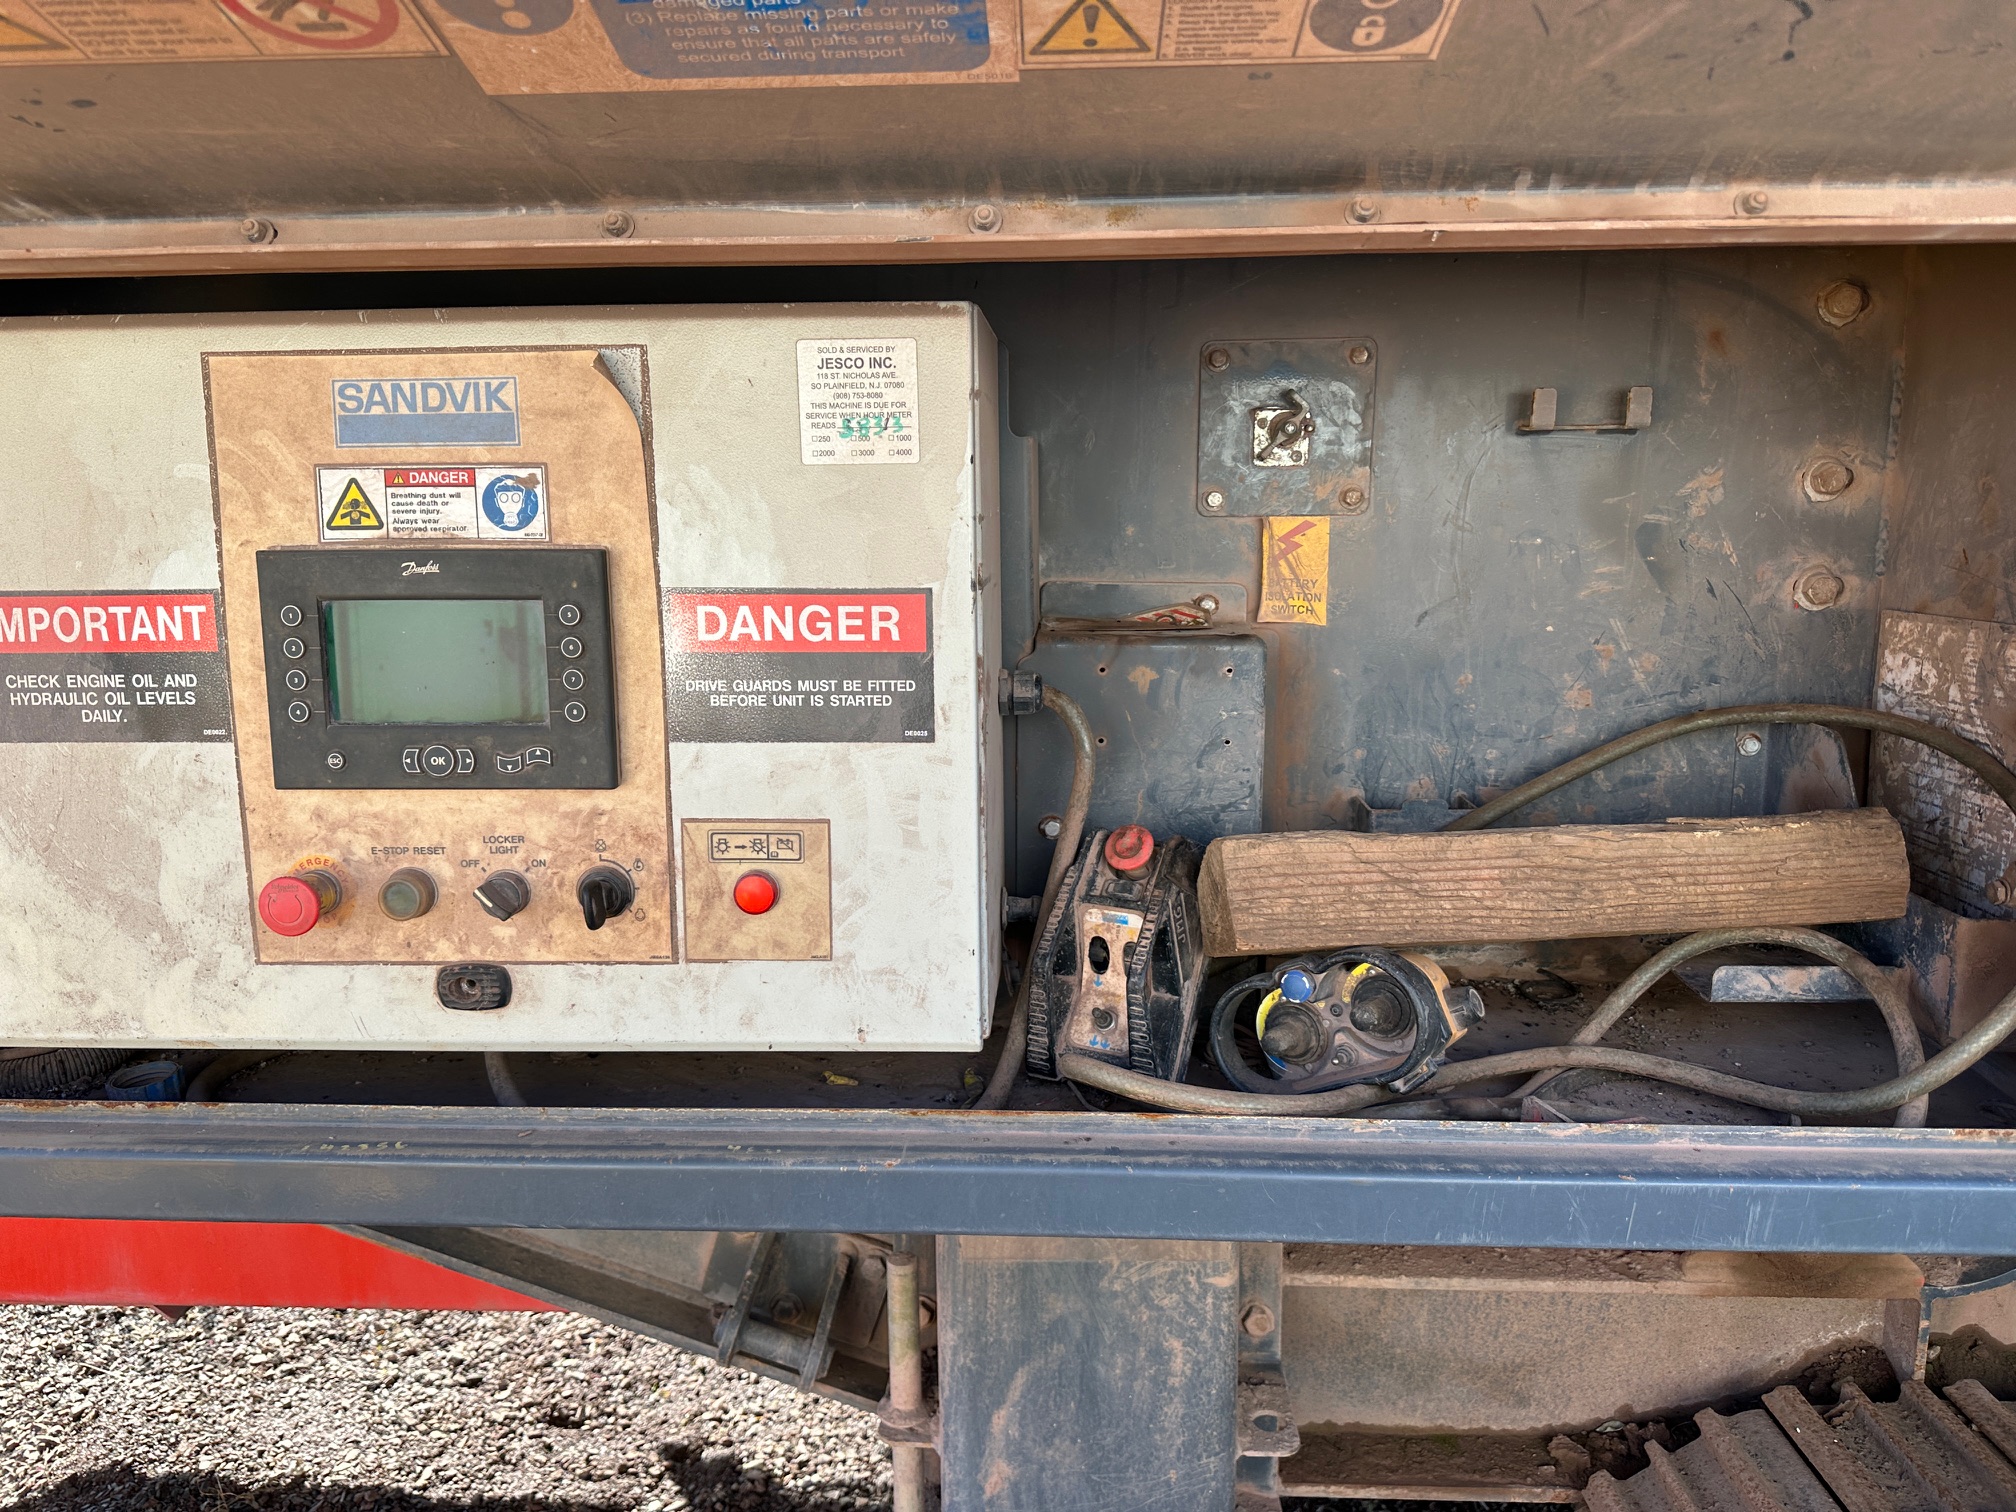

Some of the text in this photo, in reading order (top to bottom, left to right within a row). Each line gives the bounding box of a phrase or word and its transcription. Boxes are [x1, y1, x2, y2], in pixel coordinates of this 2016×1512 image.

[748, 0, 801, 8] parts
[625, 4, 959, 26] (3) Replace missing parts or make
[665, 18, 949, 38] repairs as found necessary to
[672, 31, 957, 50] ensure that all parts are safely
[677, 47, 906, 64] secured during transport
[817, 346, 837, 354] SOLD
[839, 346, 844, 354] &
[886, 345, 895, 353] BY
[817, 356, 897, 370] JESCO INC.
[882, 371, 899, 379] AVE.
[823, 382, 867, 391] PLAINFIELD,
[884, 381, 904, 389] 07080
[337, 381, 513, 414] SANDVIK
[833, 392, 850, 400] (908)
[810, 402, 827, 410] THIS
[863, 411, 885, 419] HOUR
[818, 449, 835, 457] 2000
[409, 472, 469, 484] DANGER
[390, 492, 427, 500] Breathing
[401, 560, 440, 576] Danfoss
[1268, 578, 1319, 590] BATTERY
[1265, 592, 1322, 603] ISOLATION
[1270, 605, 1316, 616] SWITCH
[0, 605, 206, 643] MPORTANT
[697, 604, 901, 643] DANGER
[5, 673, 198, 689] CHECK ENGINE OIL AND
[685, 680, 916, 692] DRIVE GUARDS MUST BE FITTED
[10, 691, 196, 706] HYDRAULIC OIL LEVELS
[710, 695, 892, 707] BEFORE UNIT IS STARTED
[81, 709, 128, 723] DAILY.
[430, 756, 446, 766] OK
[482, 835, 525, 843] LOCKER
[371, 846, 446, 855] E-STOP RESET
[489, 846, 519, 854] LIGHT
[460, 859, 480, 868] OFF
[531, 859, 547, 867] ON
[1173, 905, 1187, 944] JMG
